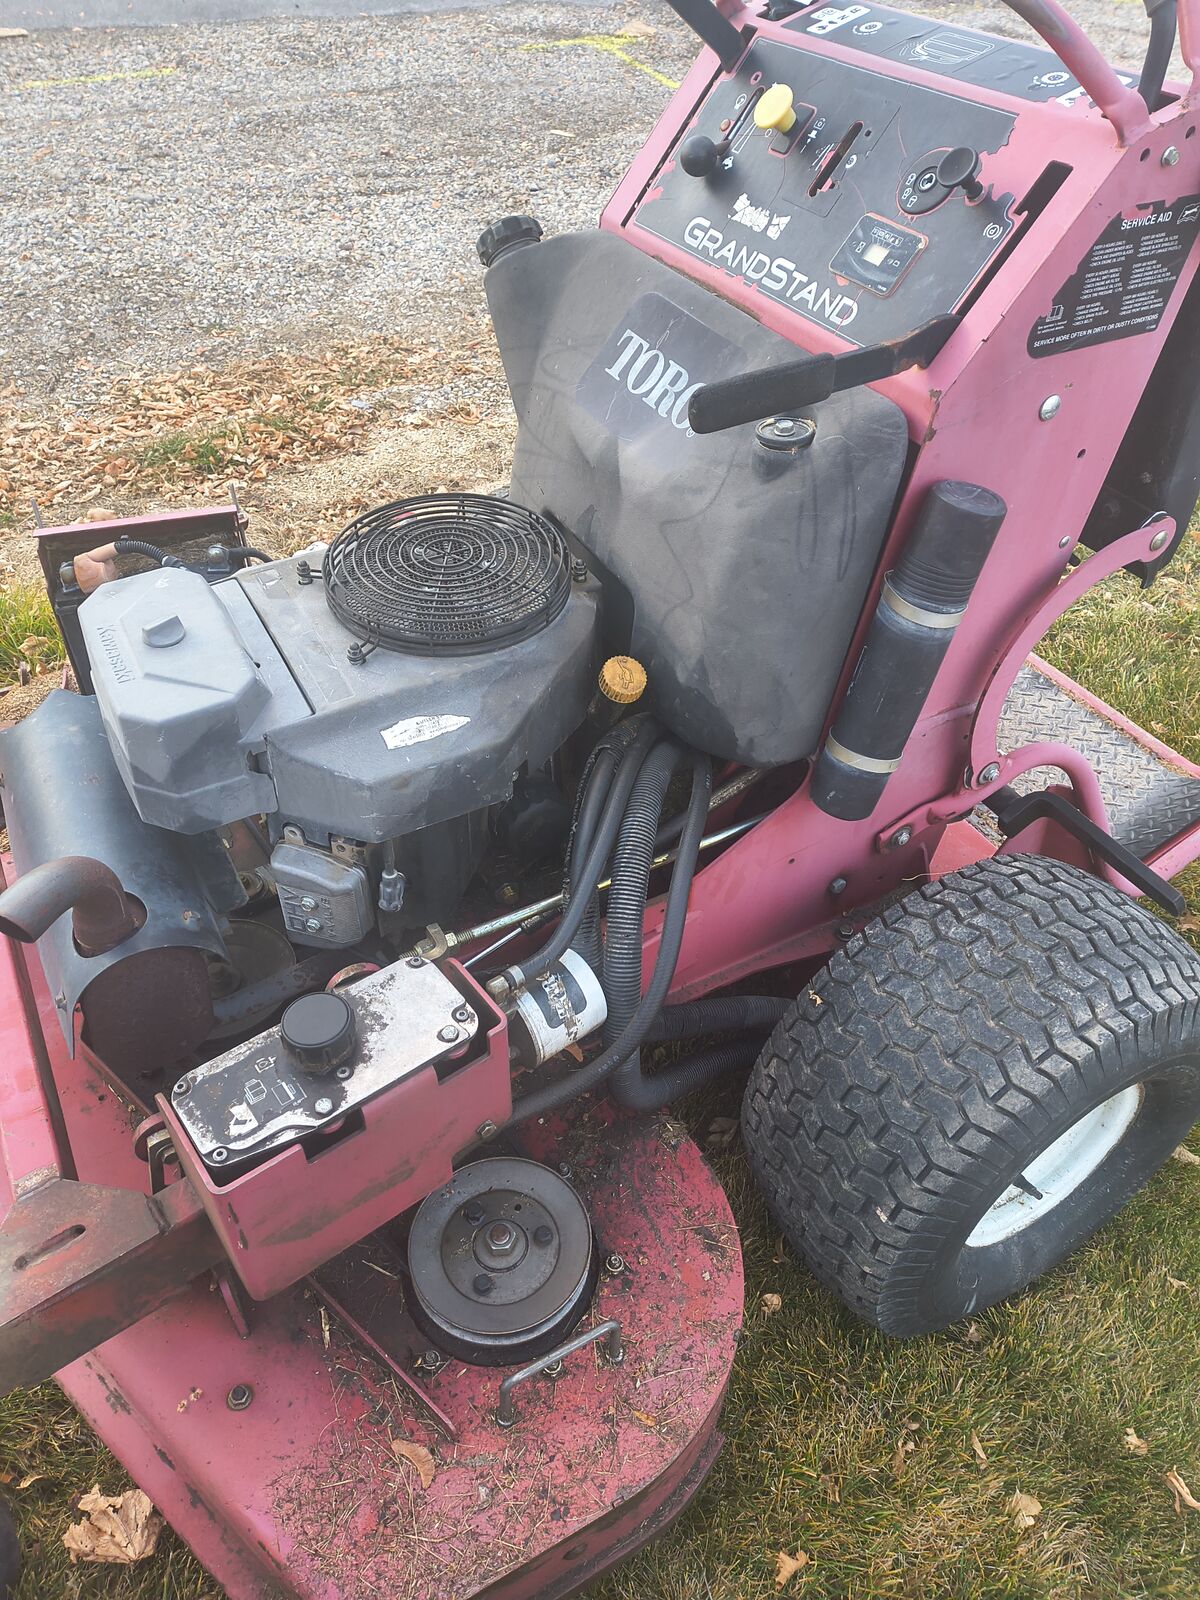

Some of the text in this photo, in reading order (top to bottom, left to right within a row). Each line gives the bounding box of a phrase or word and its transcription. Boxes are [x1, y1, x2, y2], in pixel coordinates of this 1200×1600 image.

[1121, 211, 1173, 230] SERVICE AID
[1033, 337, 1055, 347] SERVICE
[1055, 333, 1070, 343] MORE
[1070, 329, 1087, 339] OFTEN
[1093, 324, 1108, 334] DIRTY
[1107, 322, 1115, 331] OR
[1115, 319, 1131, 329] DUSTY
[1131, 313, 1159, 325] CONDITIONS
[97, 624, 137, 684] Kawasaki
